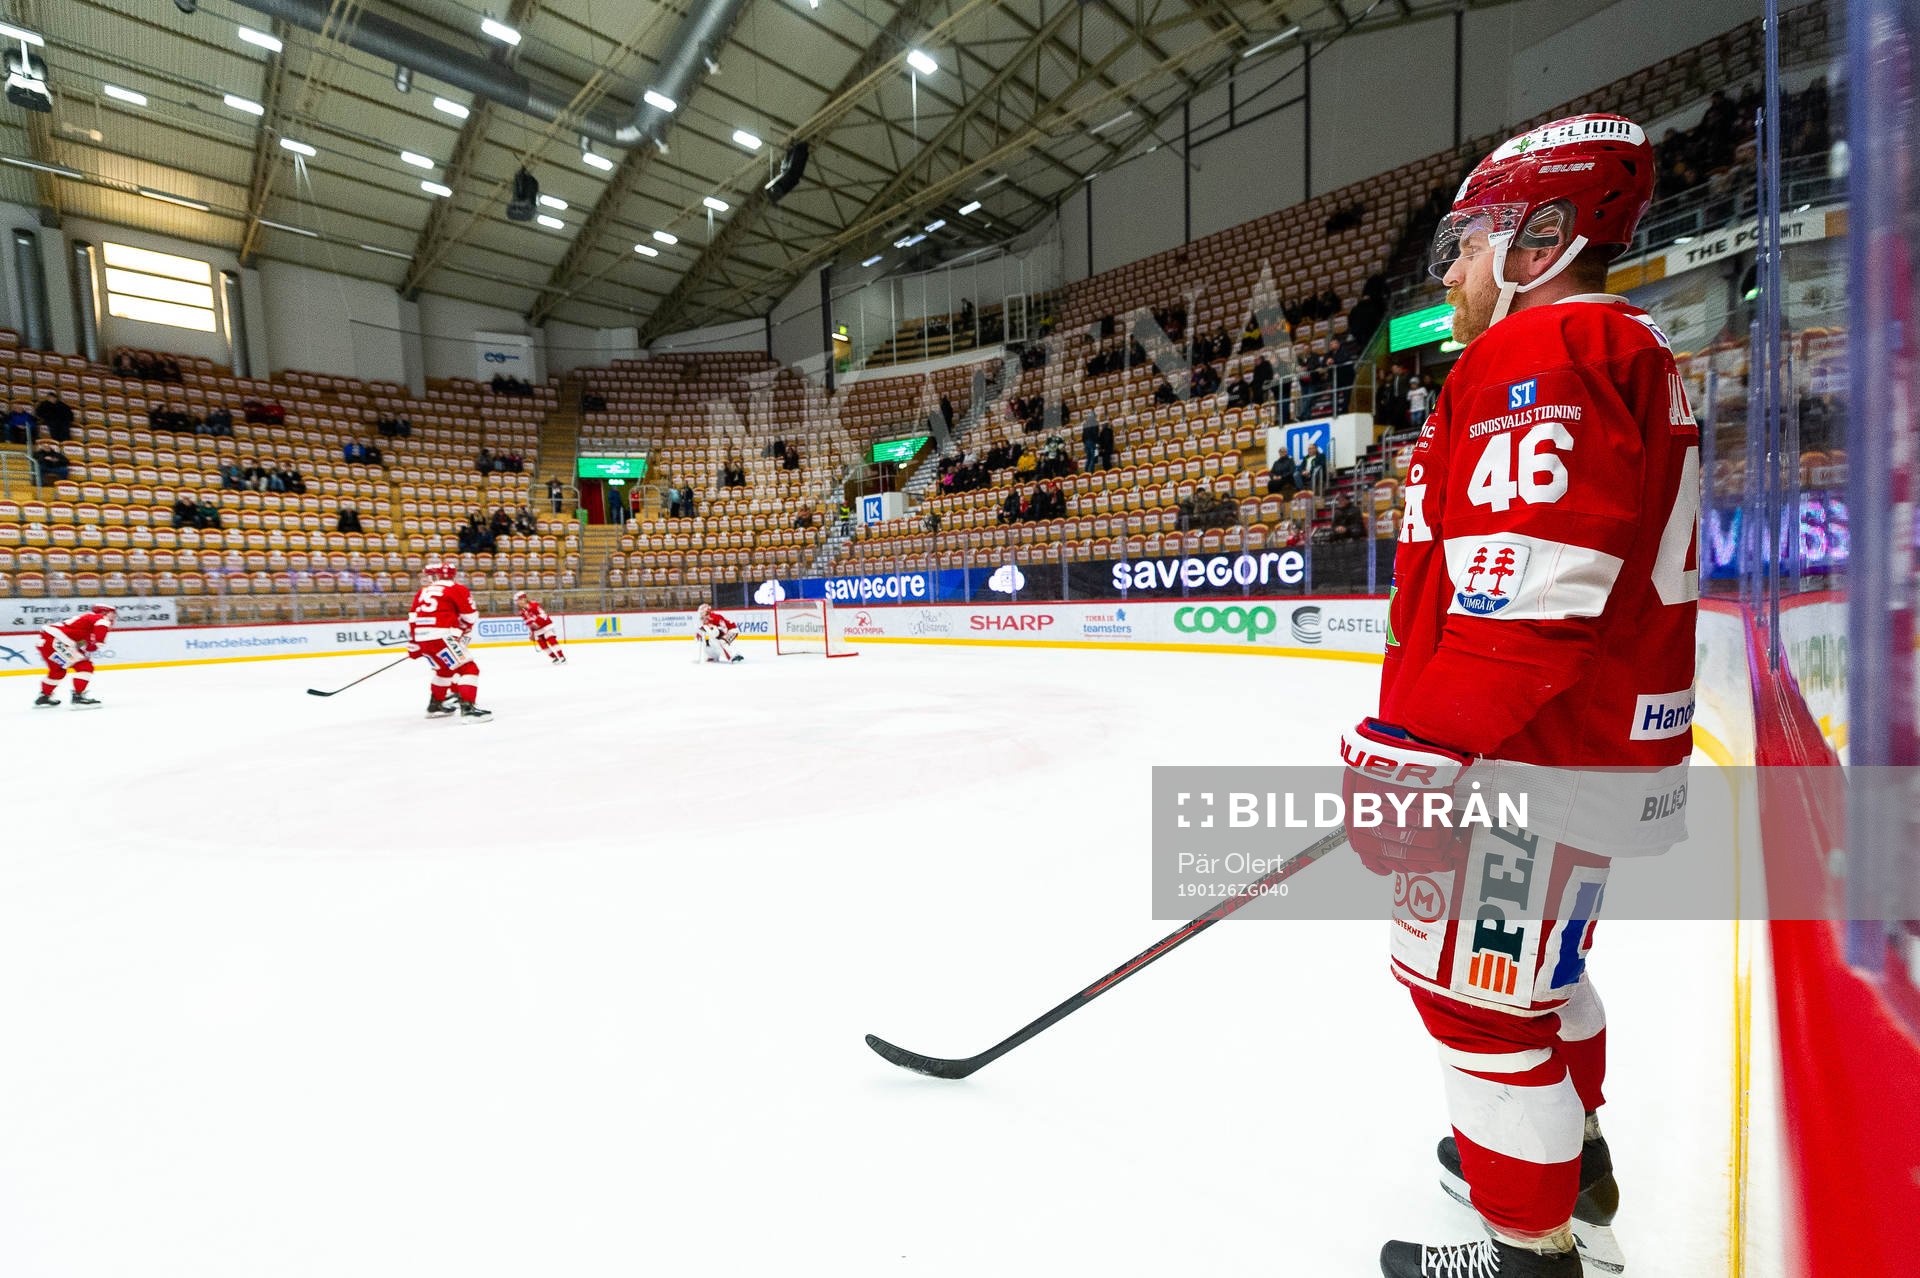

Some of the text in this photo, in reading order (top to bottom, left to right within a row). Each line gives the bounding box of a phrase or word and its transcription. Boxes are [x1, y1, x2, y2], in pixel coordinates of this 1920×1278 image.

[1538, 162, 1596, 174] BAUER
[1686, 240, 1729, 263] THE
[1511, 380, 1535, 408] ST
[1469, 405, 1582, 439] SUNDSVALLS TIDNING
[1467, 422, 1575, 512] 46
[1112, 550, 1305, 590] savecore
[824, 574, 925, 601] savecore
[1463, 597, 1496, 612] TIMRÅ IK
[970, 615, 1054, 630] SHARP
[1083, 624, 1132, 633] teamsters
[1173, 606, 1277, 641] coop
[185, 634, 308, 651] Handelsbanken
